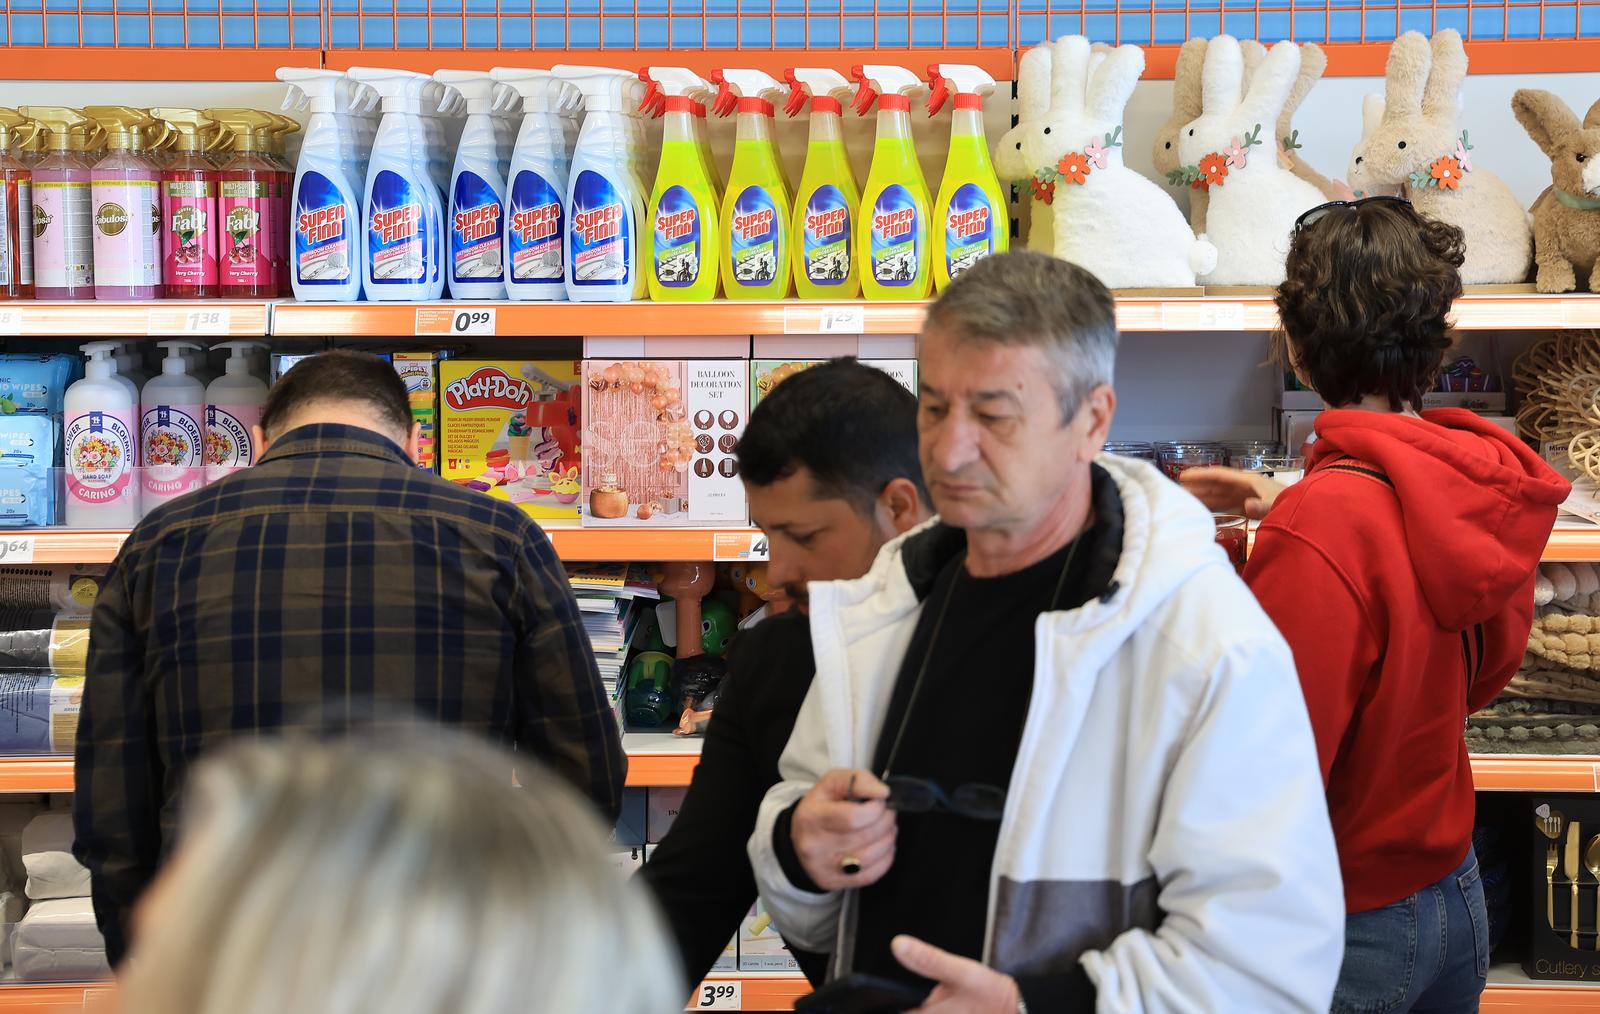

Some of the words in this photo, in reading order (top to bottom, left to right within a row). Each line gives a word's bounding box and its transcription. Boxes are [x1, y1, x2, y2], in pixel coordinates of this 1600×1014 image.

[172, 208, 207, 232] Fab!
[226, 208, 261, 232] Fab!
[299, 204, 346, 232] SUPER
[373, 203, 421, 231] SUPER
[456, 203, 500, 231] SUPER
[514, 203, 560, 231] SUPER
[575, 203, 623, 232] SUPER
[657, 207, 696, 231] SUPER
[734, 207, 773, 231] SUPER
[807, 207, 846, 231] SUPER
[875, 207, 914, 231] SUPER
[949, 207, 988, 231] SUPER
[308, 221, 342, 245] FINN
[383, 220, 417, 244] FINN
[463, 221, 496, 244] FINN
[523, 220, 557, 244] FINN
[584, 221, 619, 245] FINN
[665, 222, 692, 241] FINN
[742, 222, 770, 241] FINN
[815, 221, 843, 240] FINN
[883, 221, 910, 240] FINN
[957, 221, 985, 240] FINN
[690, 381, 742, 389] DECORATION
[697, 370, 736, 379] BALLOON
[446, 374, 532, 405] Play-Doh
[708, 391, 724, 399] SET
[65, 423, 81, 456] FLOWER
[111, 422, 131, 462] BLOEMEN
[178, 417, 201, 457] BLOEMEN
[222, 417, 248, 457] BLOEMEN
[78, 488, 116, 500] CARING
[148, 481, 183, 493] CARING
[1536, 959, 1588, 978] Cutlery
